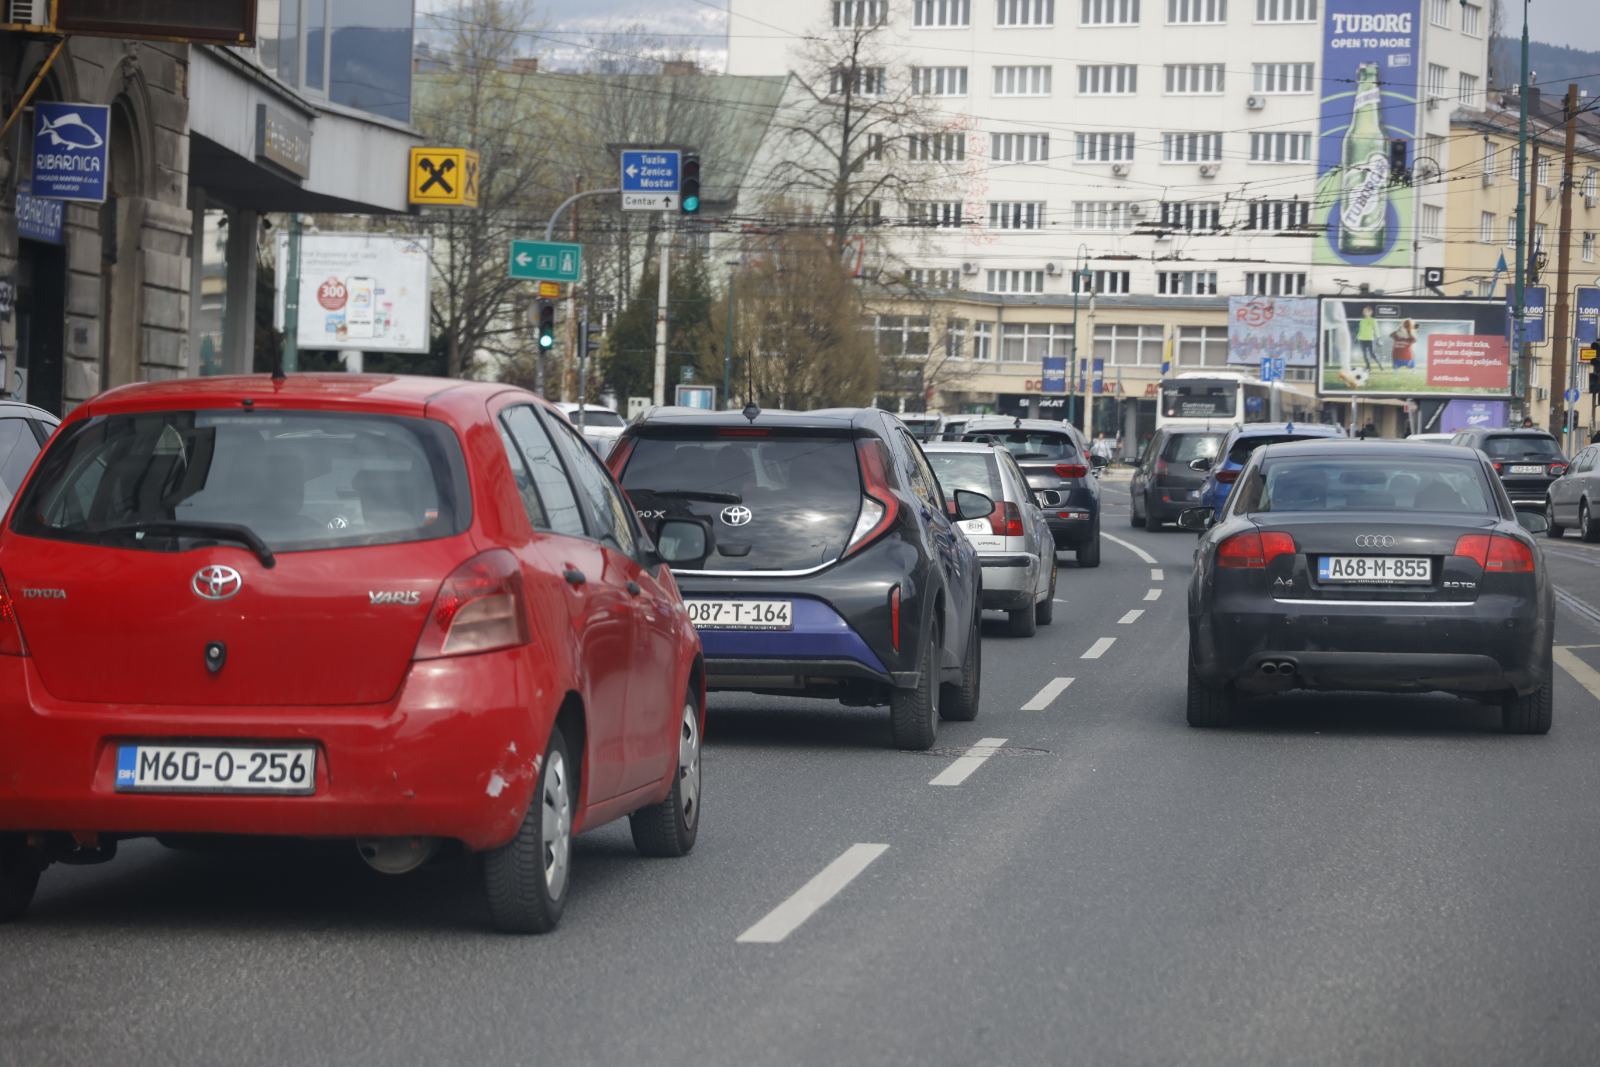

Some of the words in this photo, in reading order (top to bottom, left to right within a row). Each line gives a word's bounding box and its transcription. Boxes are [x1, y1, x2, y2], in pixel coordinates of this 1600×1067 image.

[1332, 13, 1411, 34] TUBORG
[1332, 39, 1360, 48] OPEN
[1363, 39, 1378, 48] TO
[1380, 39, 1410, 48] MORE
[37, 154, 99, 171] RIBARNICA
[641, 155, 667, 164] Tuzla
[641, 167, 672, 176] Zenica
[641, 179, 673, 188] Mostar
[625, 196, 656, 206] Centar
[321, 285, 344, 298] 300
[1332, 559, 1428, 578] A68-M-855
[1273, 576, 1294, 587] A4
[22, 589, 66, 599] TOYOTA
[368, 591, 421, 605] YARIS
